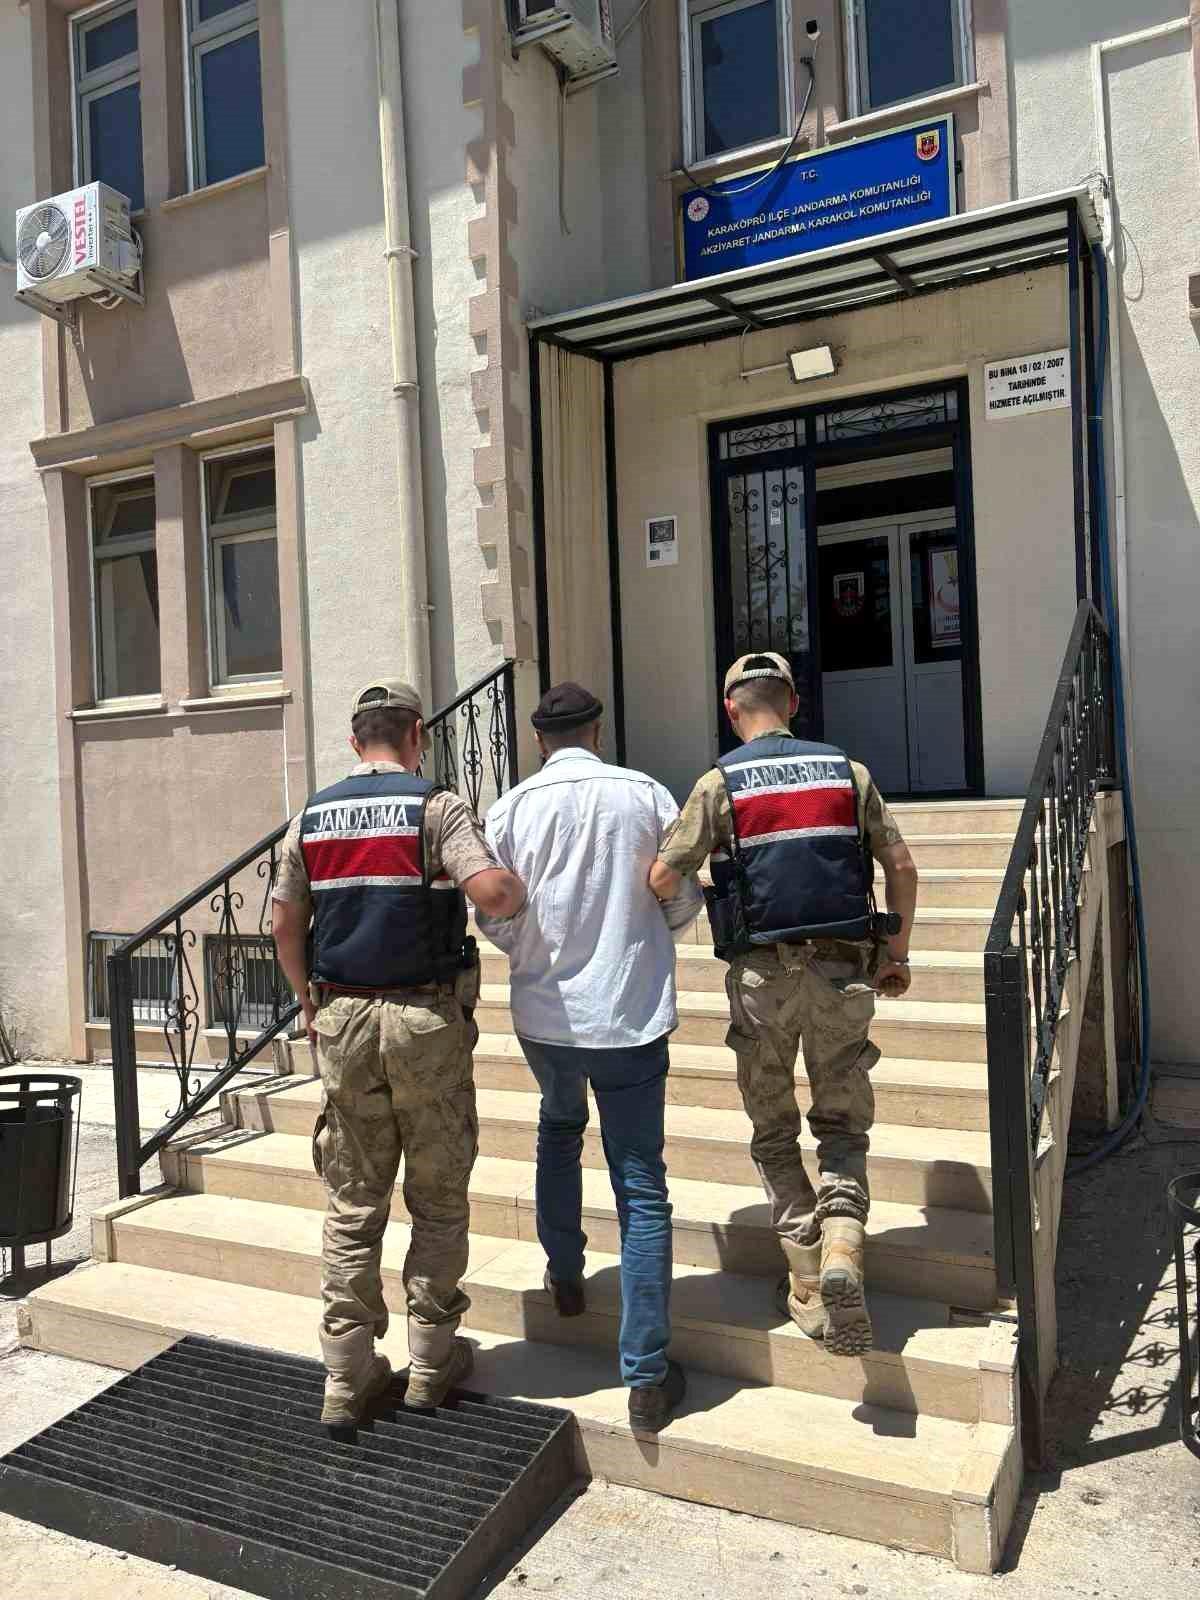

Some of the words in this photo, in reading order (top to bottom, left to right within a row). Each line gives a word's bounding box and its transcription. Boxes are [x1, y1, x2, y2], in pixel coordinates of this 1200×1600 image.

[800, 169, 819, 180] T.C.
[707, 213, 766, 238] KARAKÖPRÜ
[792, 193, 848, 216] JANDARMA
[849, 174, 921, 201] KOMUTANLIĞI
[74, 193, 87, 265] VESTEL
[700, 235, 751, 257] AKZİYARET
[752, 222, 807, 244] JANDARMA
[808, 211, 857, 229] KARAKOL
[859, 190, 931, 217] KOMUTANLIĞI
[988, 369, 999, 379] BU
[1032, 361, 1042, 371] 02
[1046, 357, 1065, 369] 2007
[740, 760, 840, 790] JANDARMA
[313, 804, 409, 832] JANDARMA
